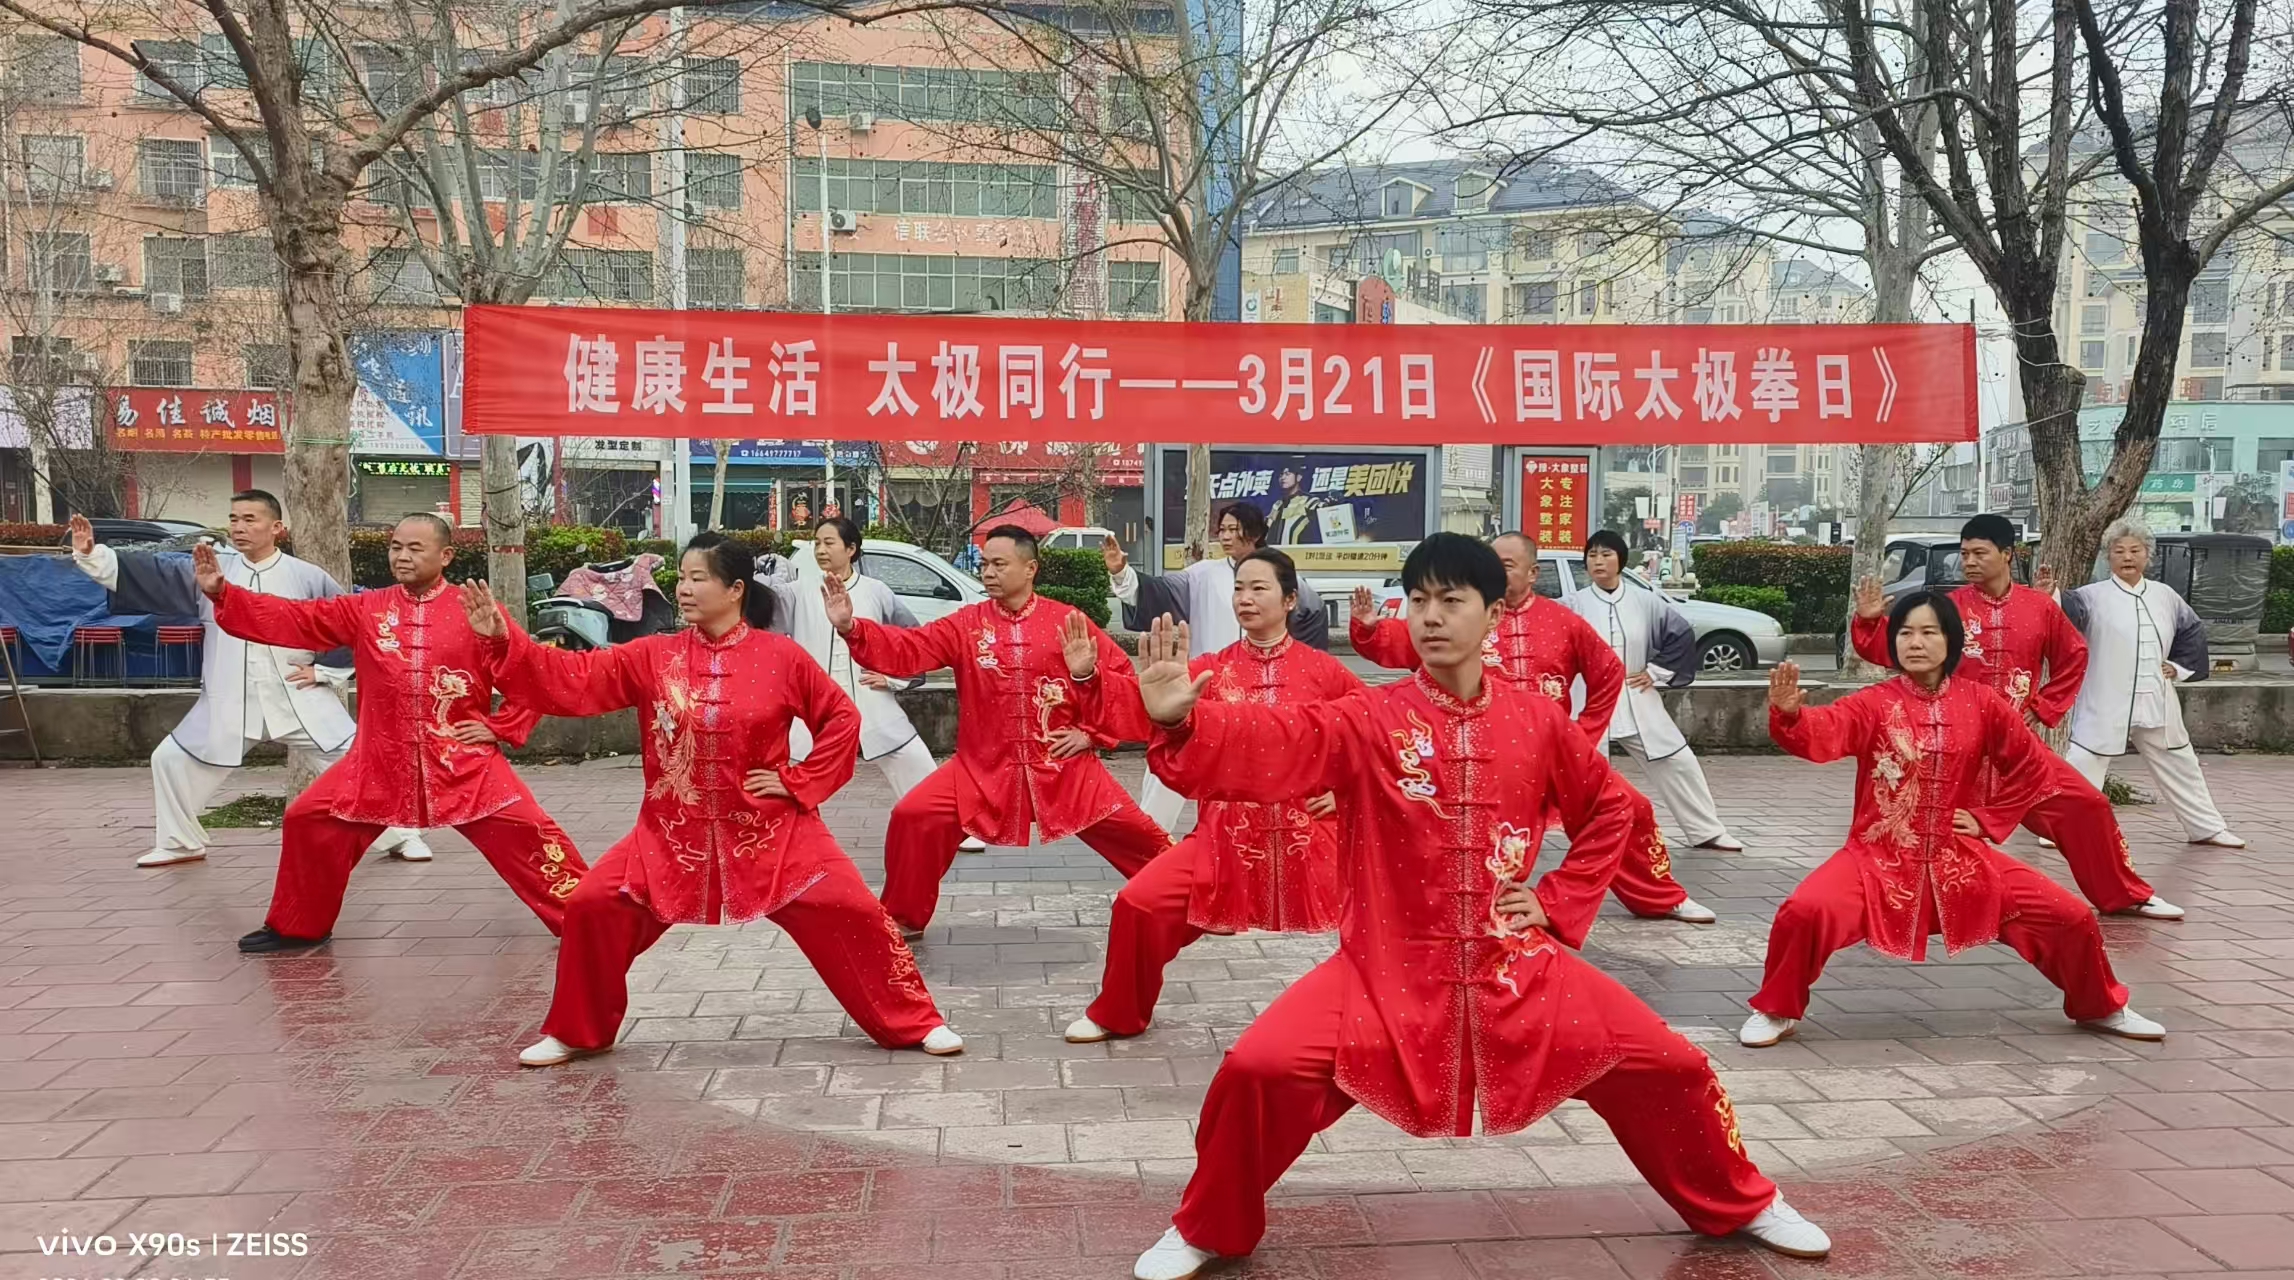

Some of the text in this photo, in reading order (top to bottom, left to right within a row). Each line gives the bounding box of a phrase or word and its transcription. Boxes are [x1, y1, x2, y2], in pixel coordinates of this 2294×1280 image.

[564, 333, 818, 416] 健康生活
[595, 440, 641, 451] 发型定制
[1309, 461, 1415, 498] 还是美团快
[1539, 477, 1554, 543] 大象整装
